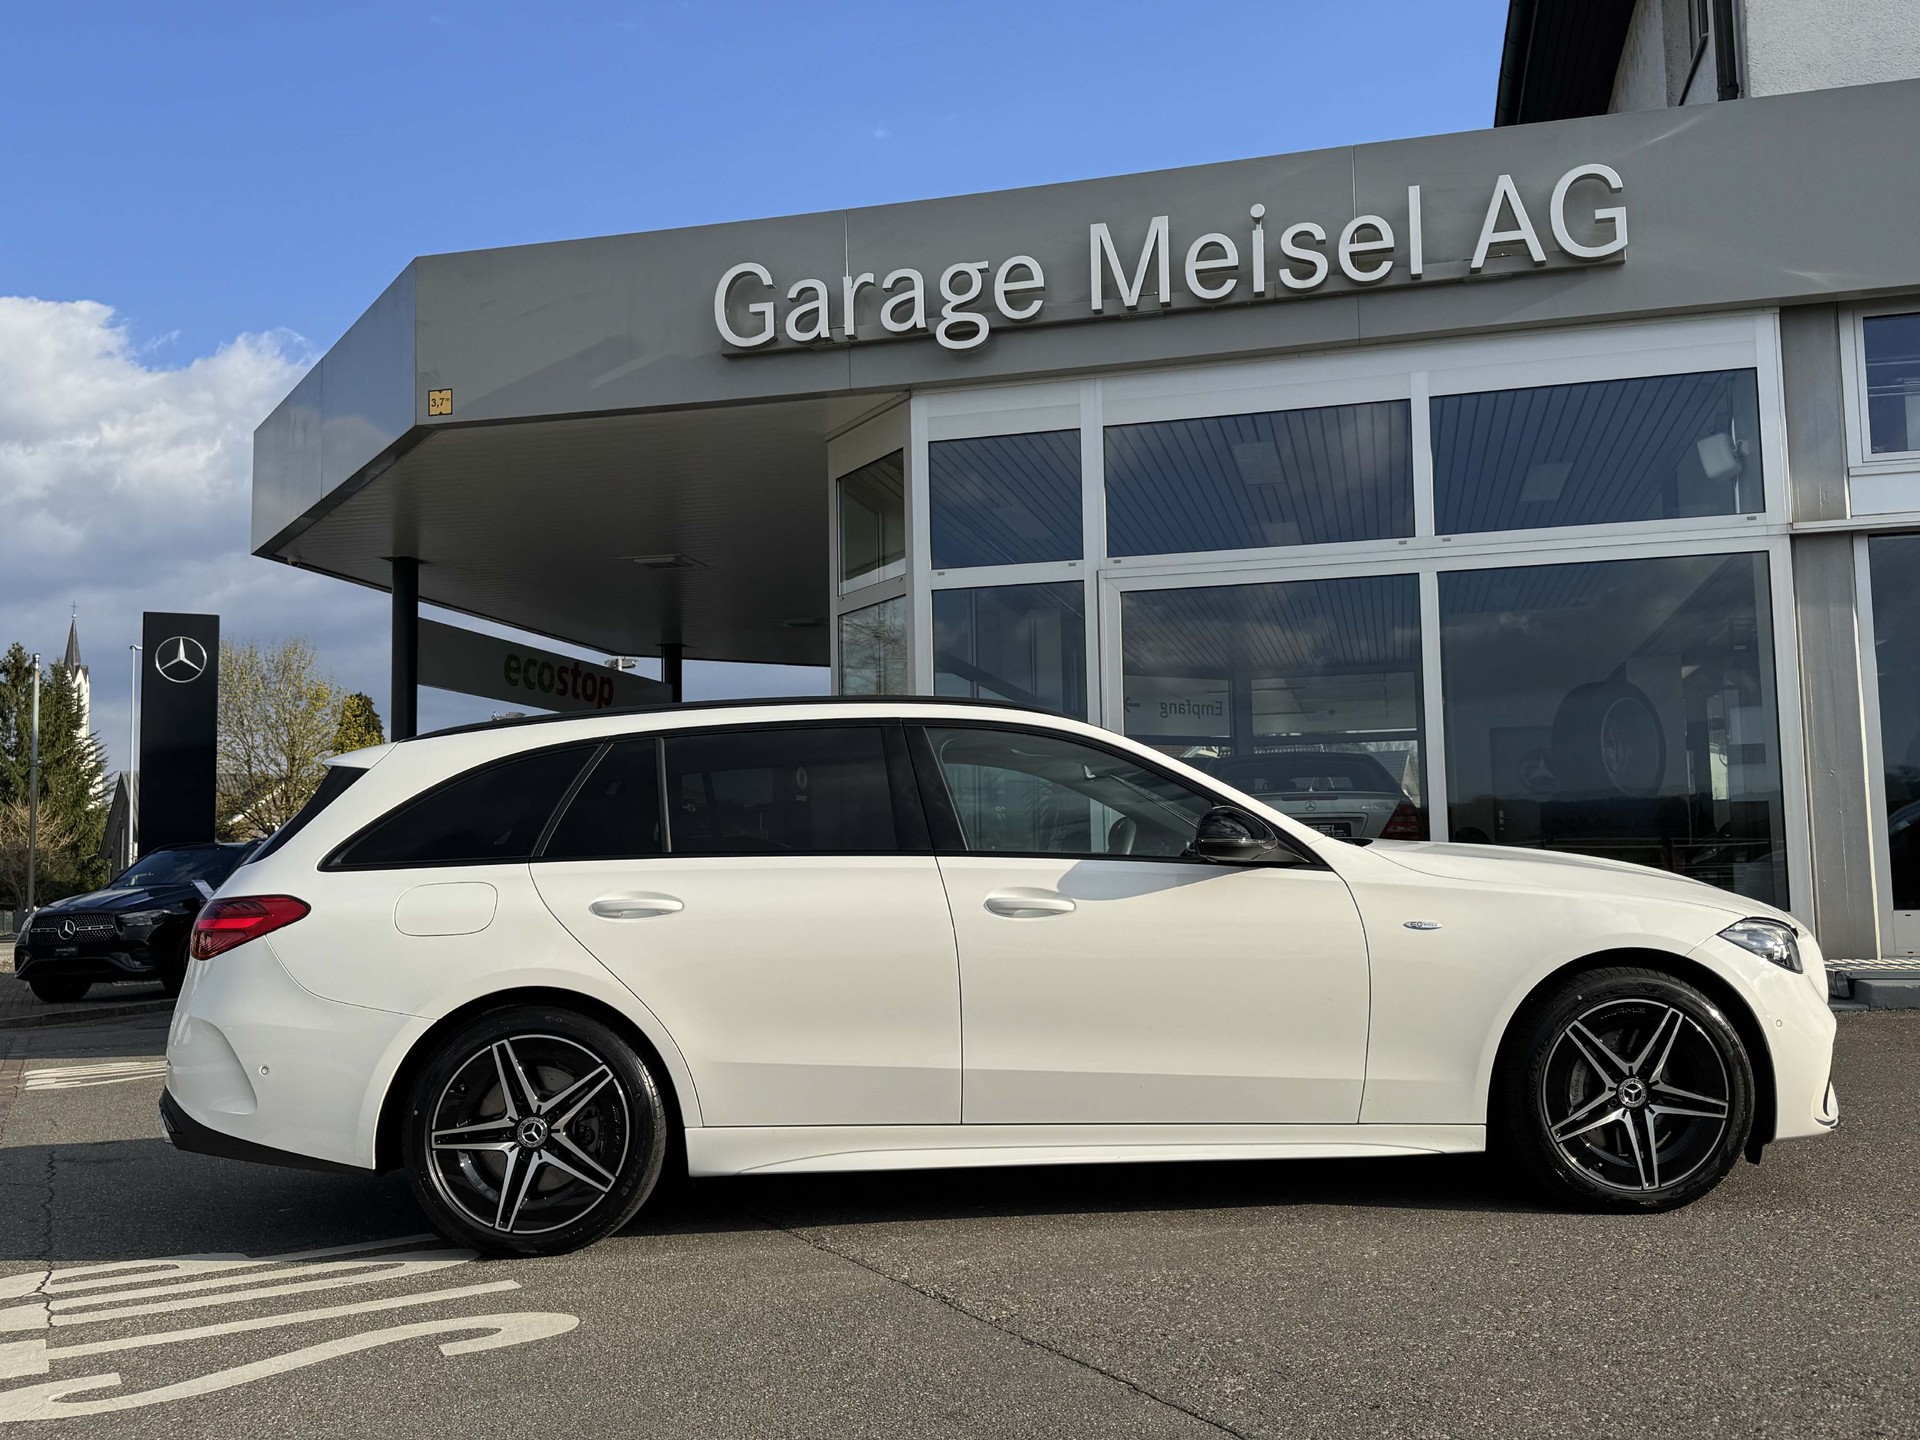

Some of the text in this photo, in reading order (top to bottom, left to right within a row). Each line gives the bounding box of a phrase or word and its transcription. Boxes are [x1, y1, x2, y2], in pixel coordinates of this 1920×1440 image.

[714, 163, 1629, 350] Garage Meisel AG
[504, 652, 614, 709] ecostop
